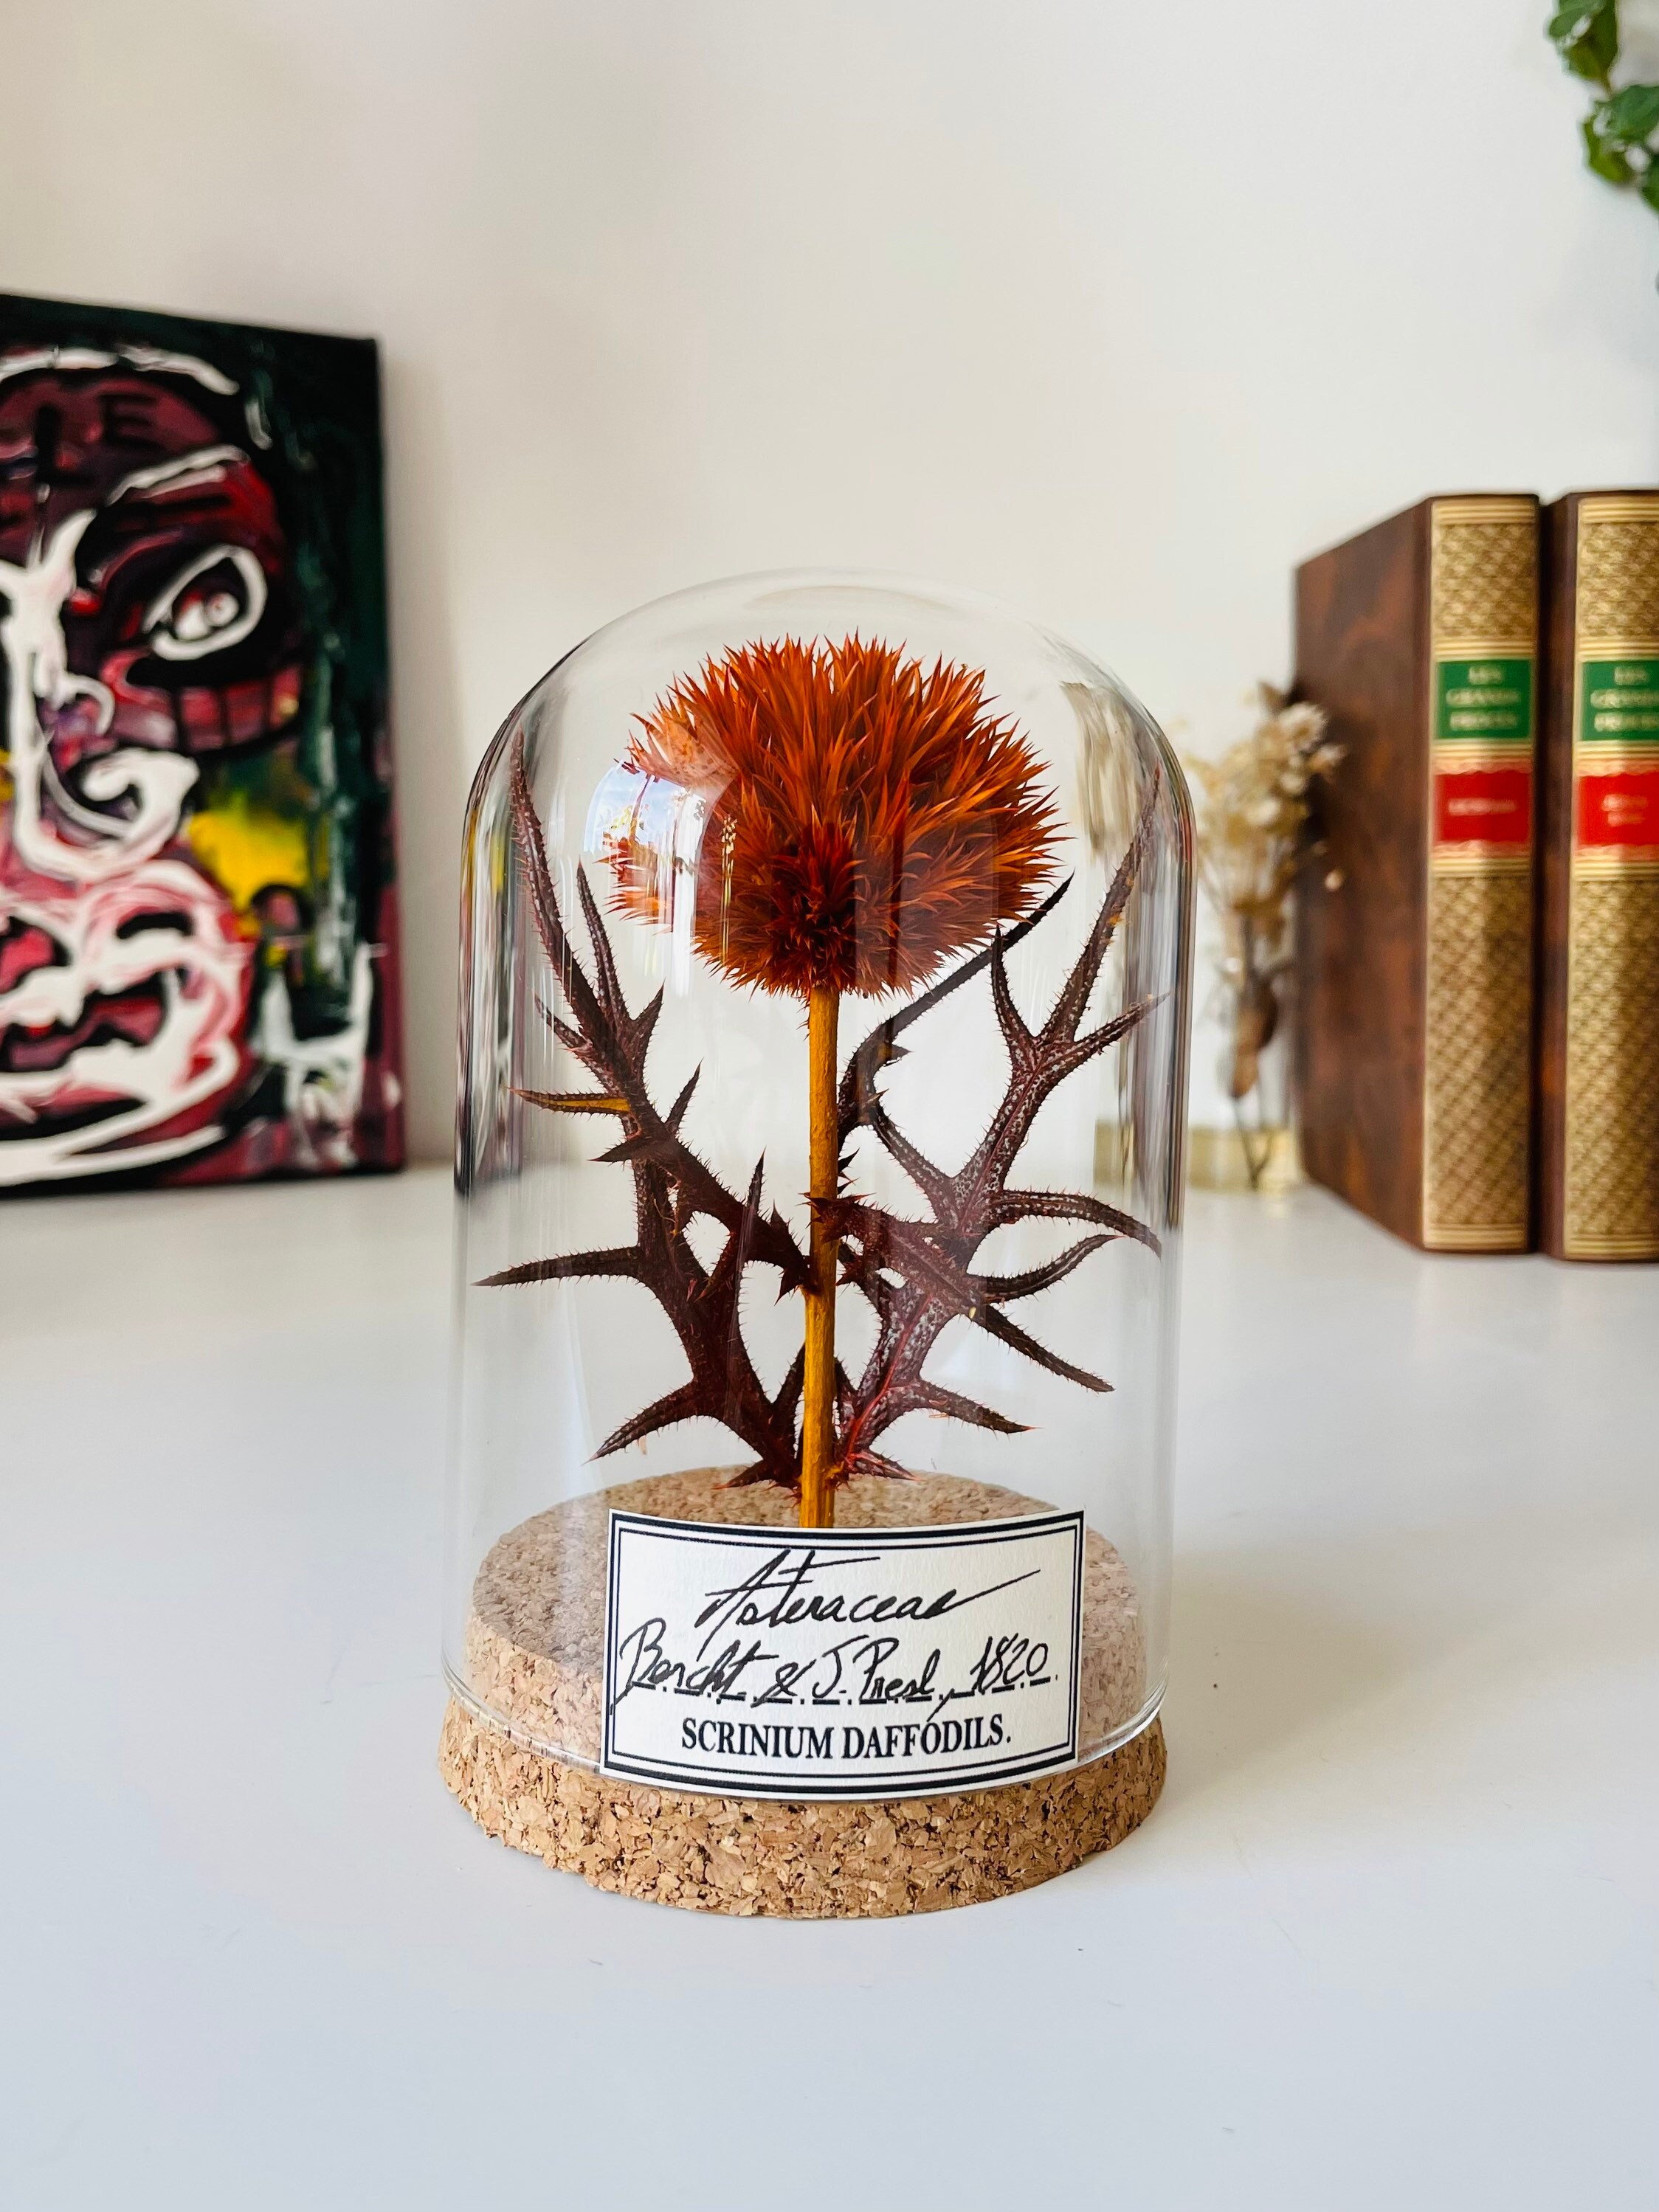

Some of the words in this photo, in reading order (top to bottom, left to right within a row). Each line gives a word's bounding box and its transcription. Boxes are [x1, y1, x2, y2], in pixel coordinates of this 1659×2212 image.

[751, 1659, 817, 1708] &
[681, 1717, 834, 1759] SCRINIUM
[841, 1713, 1012, 1759] DAFFODILS.
